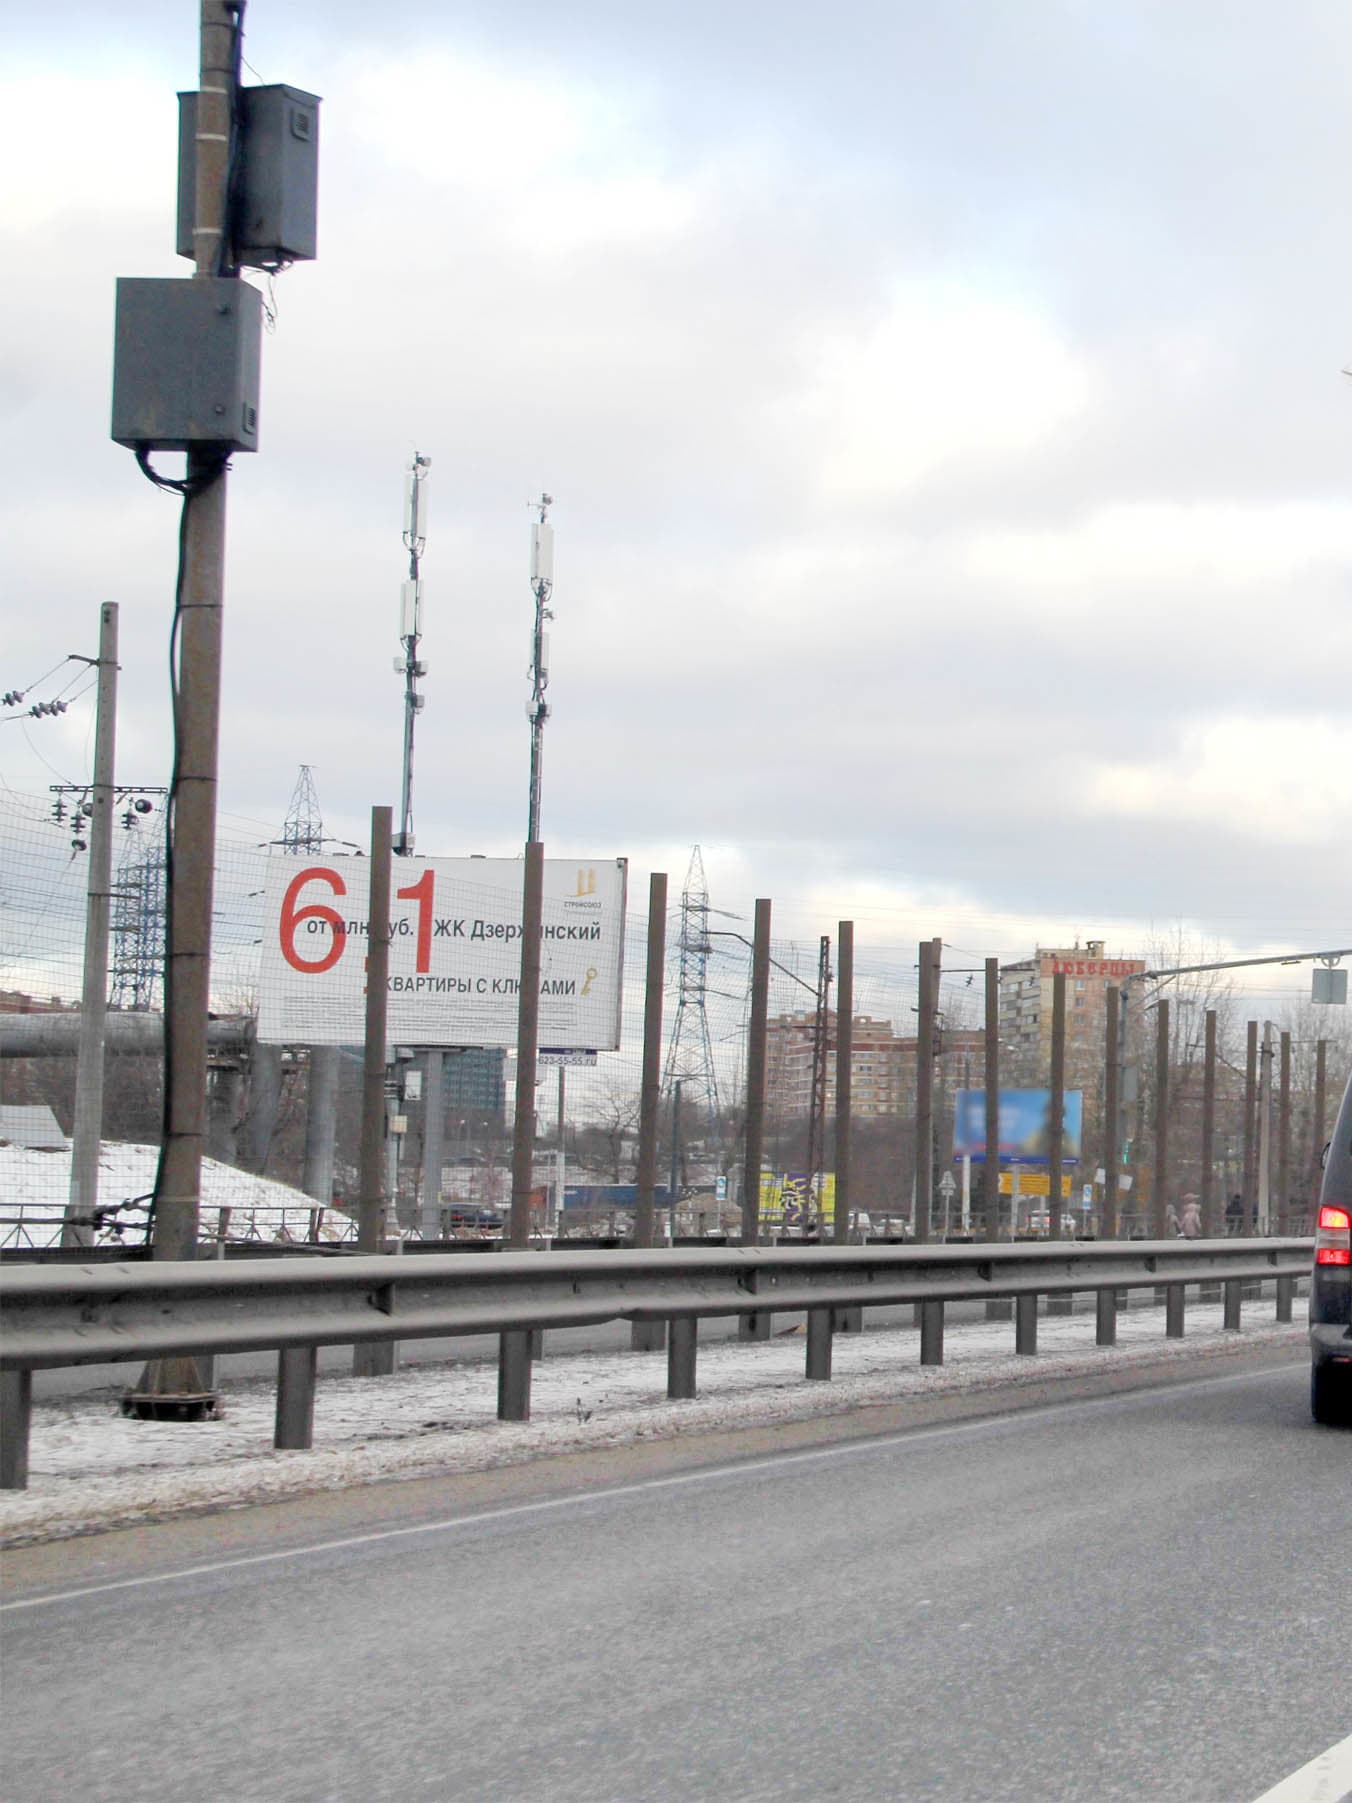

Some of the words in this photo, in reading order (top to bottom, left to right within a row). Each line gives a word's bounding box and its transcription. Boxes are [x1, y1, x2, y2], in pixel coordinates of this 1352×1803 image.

[307, 920, 327, 934] от
[388, 918, 414, 939] уб.
[433, 919, 465, 937] ЖК
[470, 919, 601, 943] Дзернский
[476, 978, 487, 993] С
[492, 978, 576, 996] КЛАМИ
